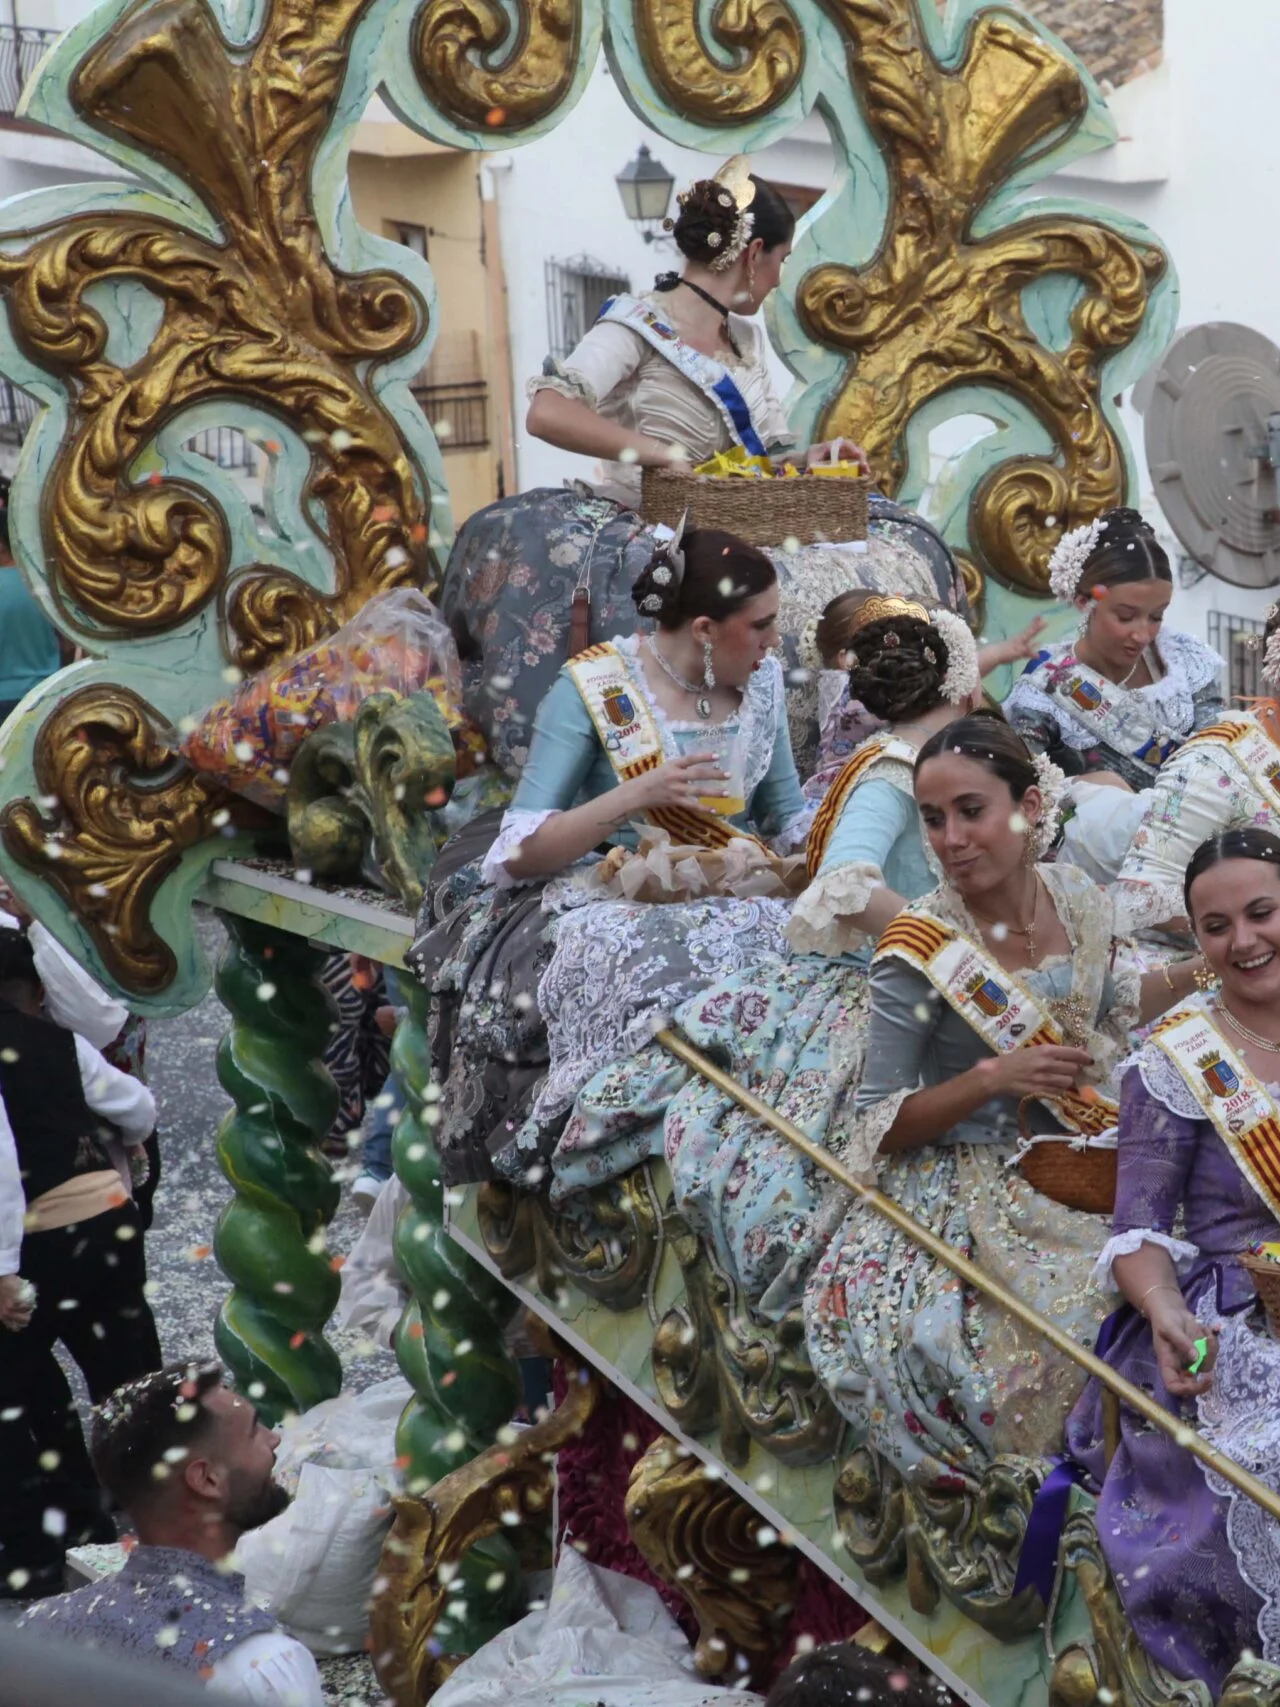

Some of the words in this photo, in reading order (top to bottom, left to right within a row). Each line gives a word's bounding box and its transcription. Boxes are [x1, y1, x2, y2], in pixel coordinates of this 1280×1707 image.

[616, 722, 641, 739] 2018
[996, 1004, 1021, 1031] 2018
[1222, 1091, 1252, 1113] 2018
